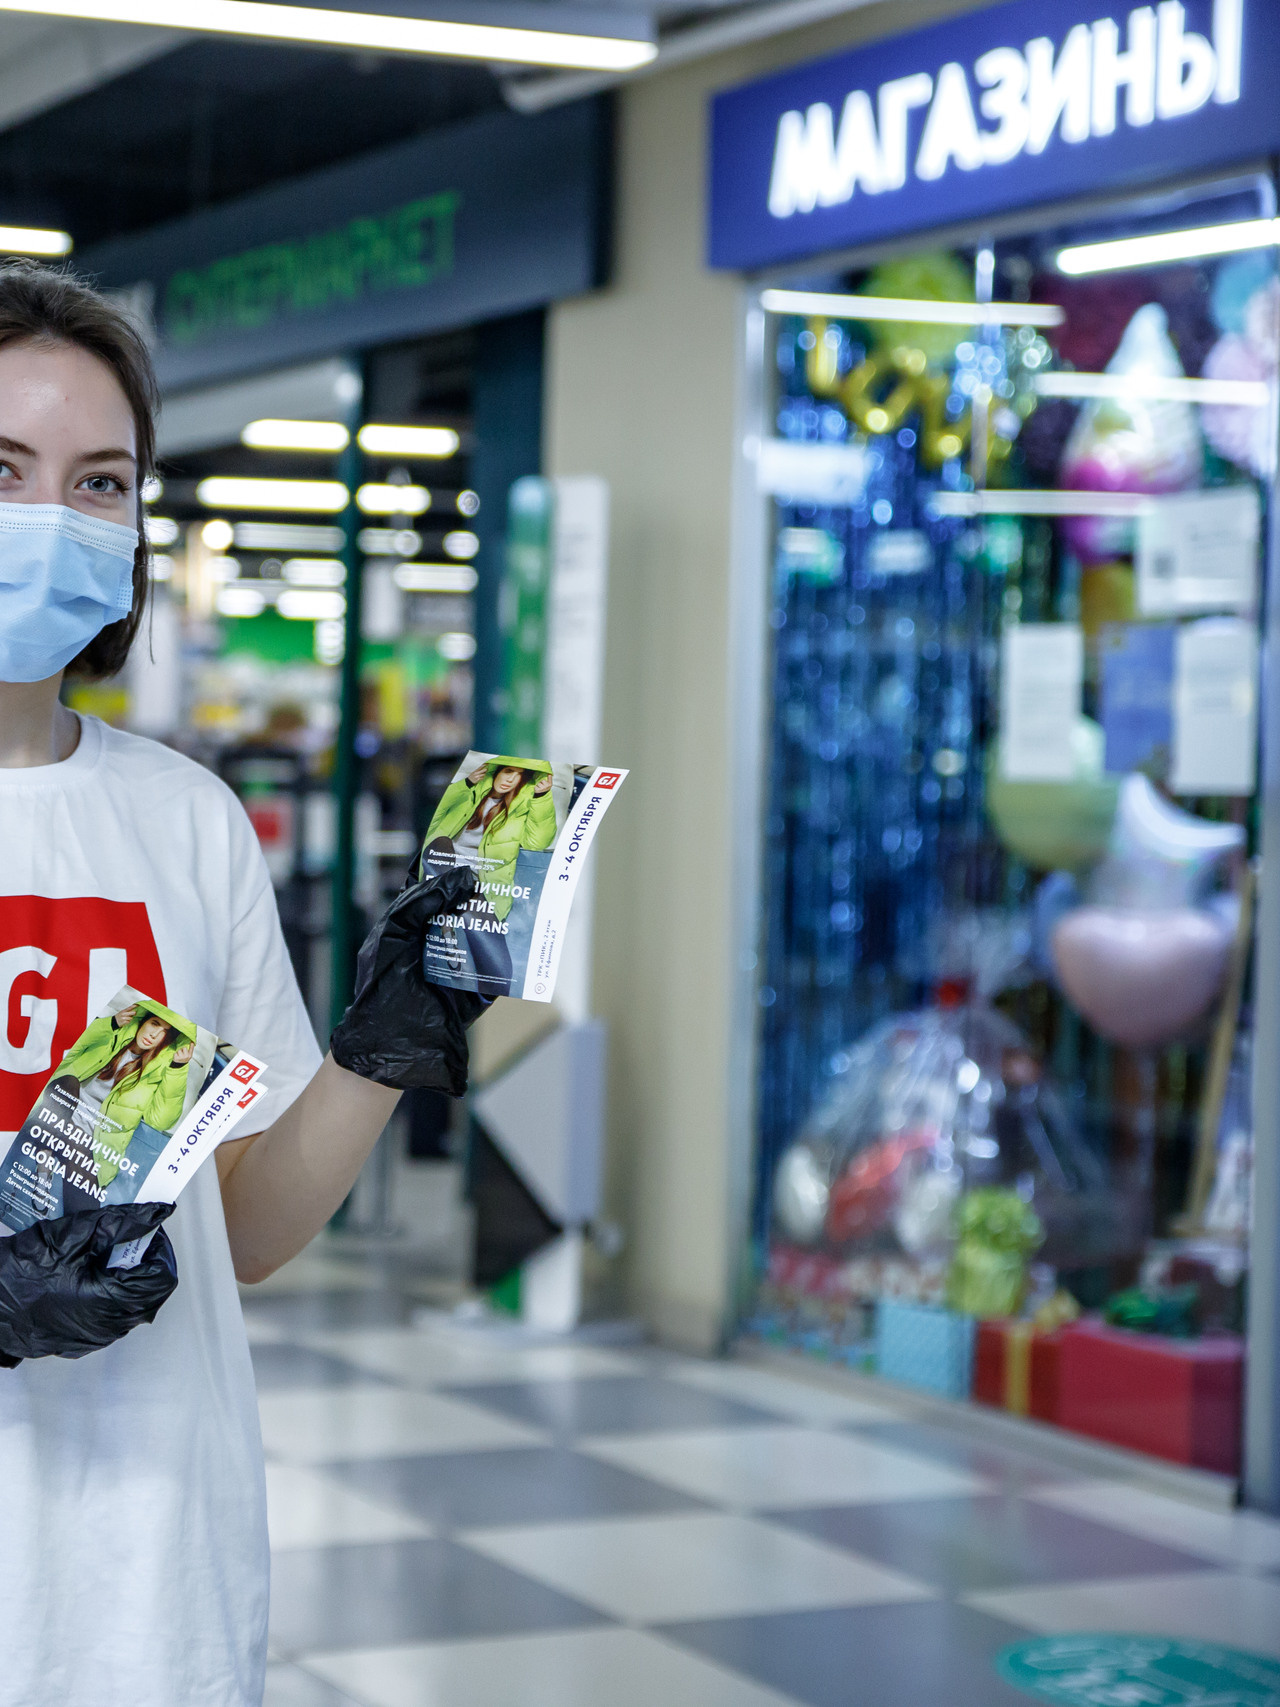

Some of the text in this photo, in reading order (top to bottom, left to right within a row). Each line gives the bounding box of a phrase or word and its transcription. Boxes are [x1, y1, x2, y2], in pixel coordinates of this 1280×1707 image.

[769, 0, 1245, 218] МАГАЗИНЫ
[569, 796, 602, 852] ОКТЯБРЯ
[565, 855, 575, 863] 4
[468, 918, 510, 935] JEANS
[30, 1125, 102, 1176] ОТКРЫТИЕ
[38, 1107, 140, 1177] ПРАЗДНИЧНОЕ
[168, 1164, 178, 1174] 3
[180, 1147, 190, 1156] 4
[186, 1087, 234, 1145] ОКТЯБРЯ
[18, 1164, 32, 1176] 12:00
[38, 1177, 52, 1190] 18:00
[21, 1142, 108, 1203] GLORIA JEANS
